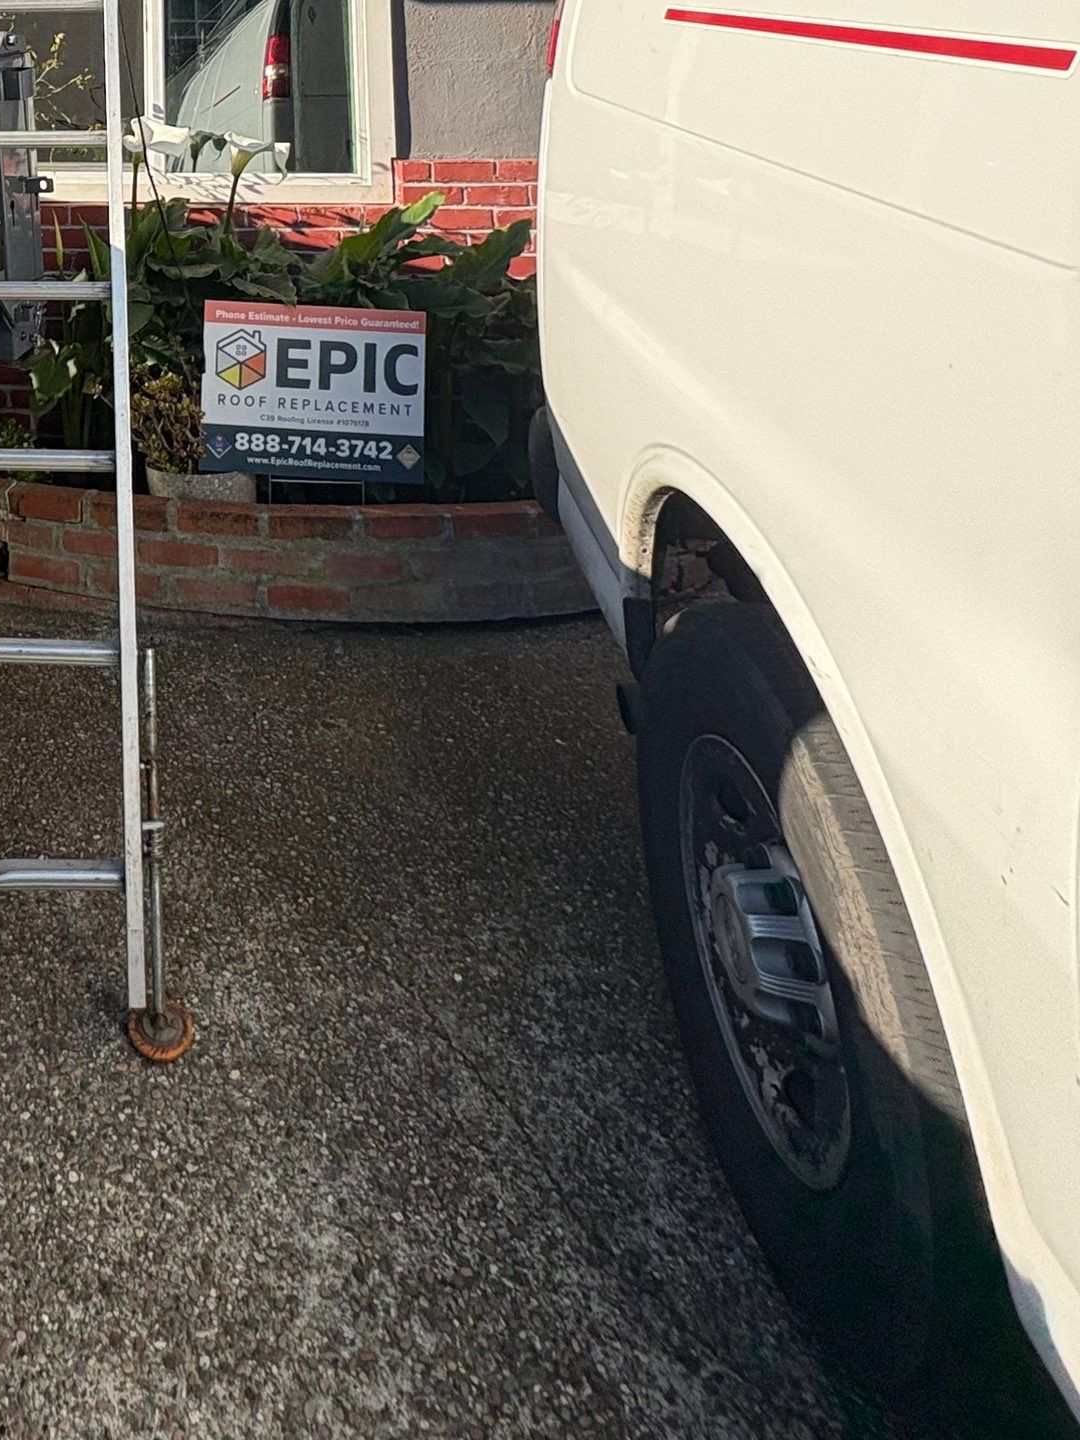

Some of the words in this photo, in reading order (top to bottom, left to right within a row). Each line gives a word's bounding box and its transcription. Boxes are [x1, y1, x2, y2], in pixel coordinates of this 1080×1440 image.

[215, 310, 246, 320] Phone
[248, 311, 290, 323] Estimate
[298, 314, 333, 325] Lowest
[335, 316, 358, 327] Price
[360, 317, 420, 330] Guaranteed!
[275, 338, 419, 396] EPIC
[217, 393, 268, 408] ROOF
[277, 397, 413, 417] REPLACEMENT
[259, 414, 276, 423] C39
[277, 415, 305, 425] Roofing
[307, 416, 335, 426] License
[234, 432, 394, 461] 888-714-3742
[246, 455, 382, 473] www.EpicRoofReplacement.com
